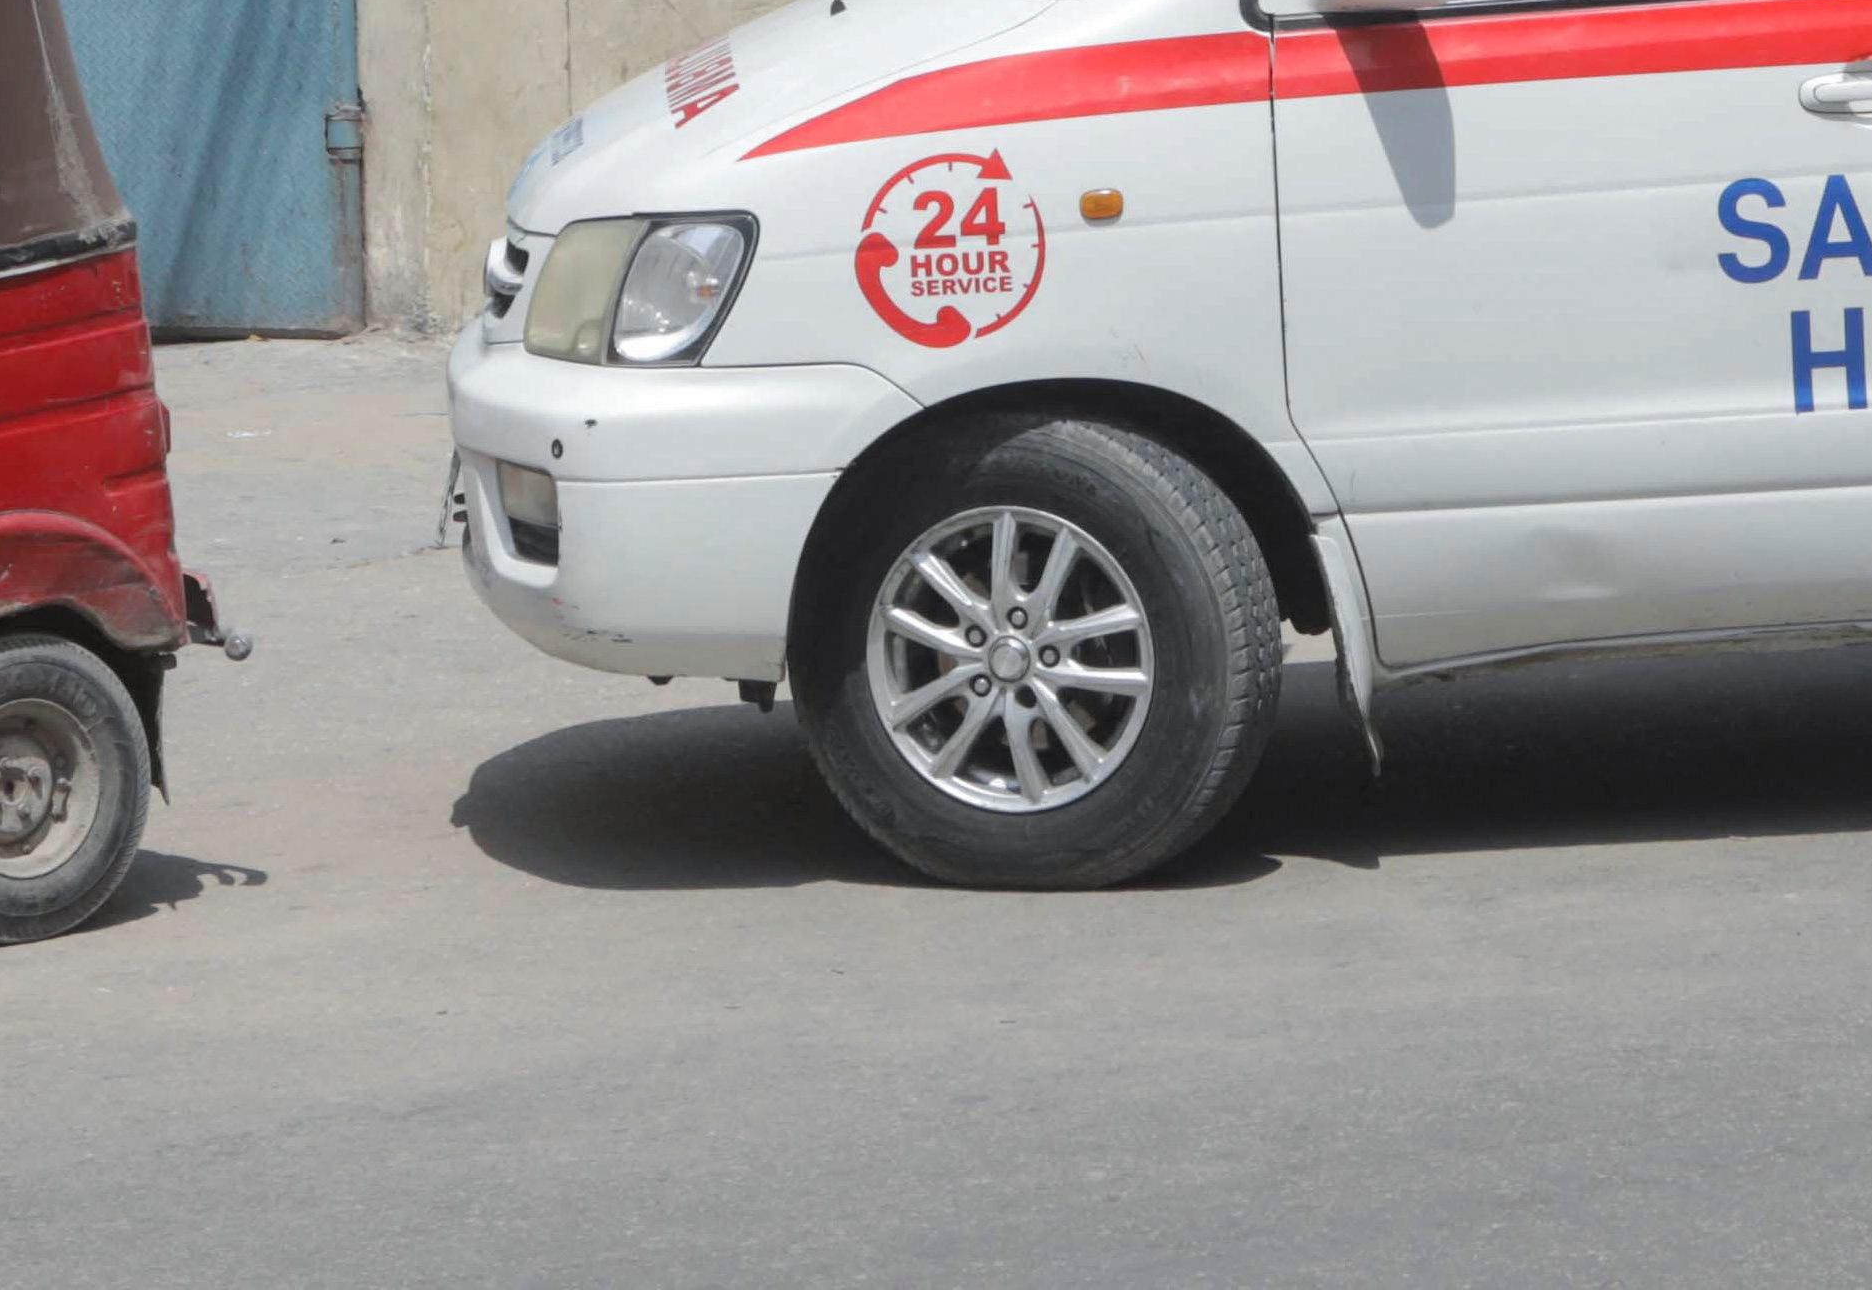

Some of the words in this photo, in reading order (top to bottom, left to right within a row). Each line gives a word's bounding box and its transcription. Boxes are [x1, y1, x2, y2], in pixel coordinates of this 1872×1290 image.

[911, 187, 1006, 249] 24
[909, 249, 1011, 280] HOUR
[909, 274, 1014, 298] SERVICE
